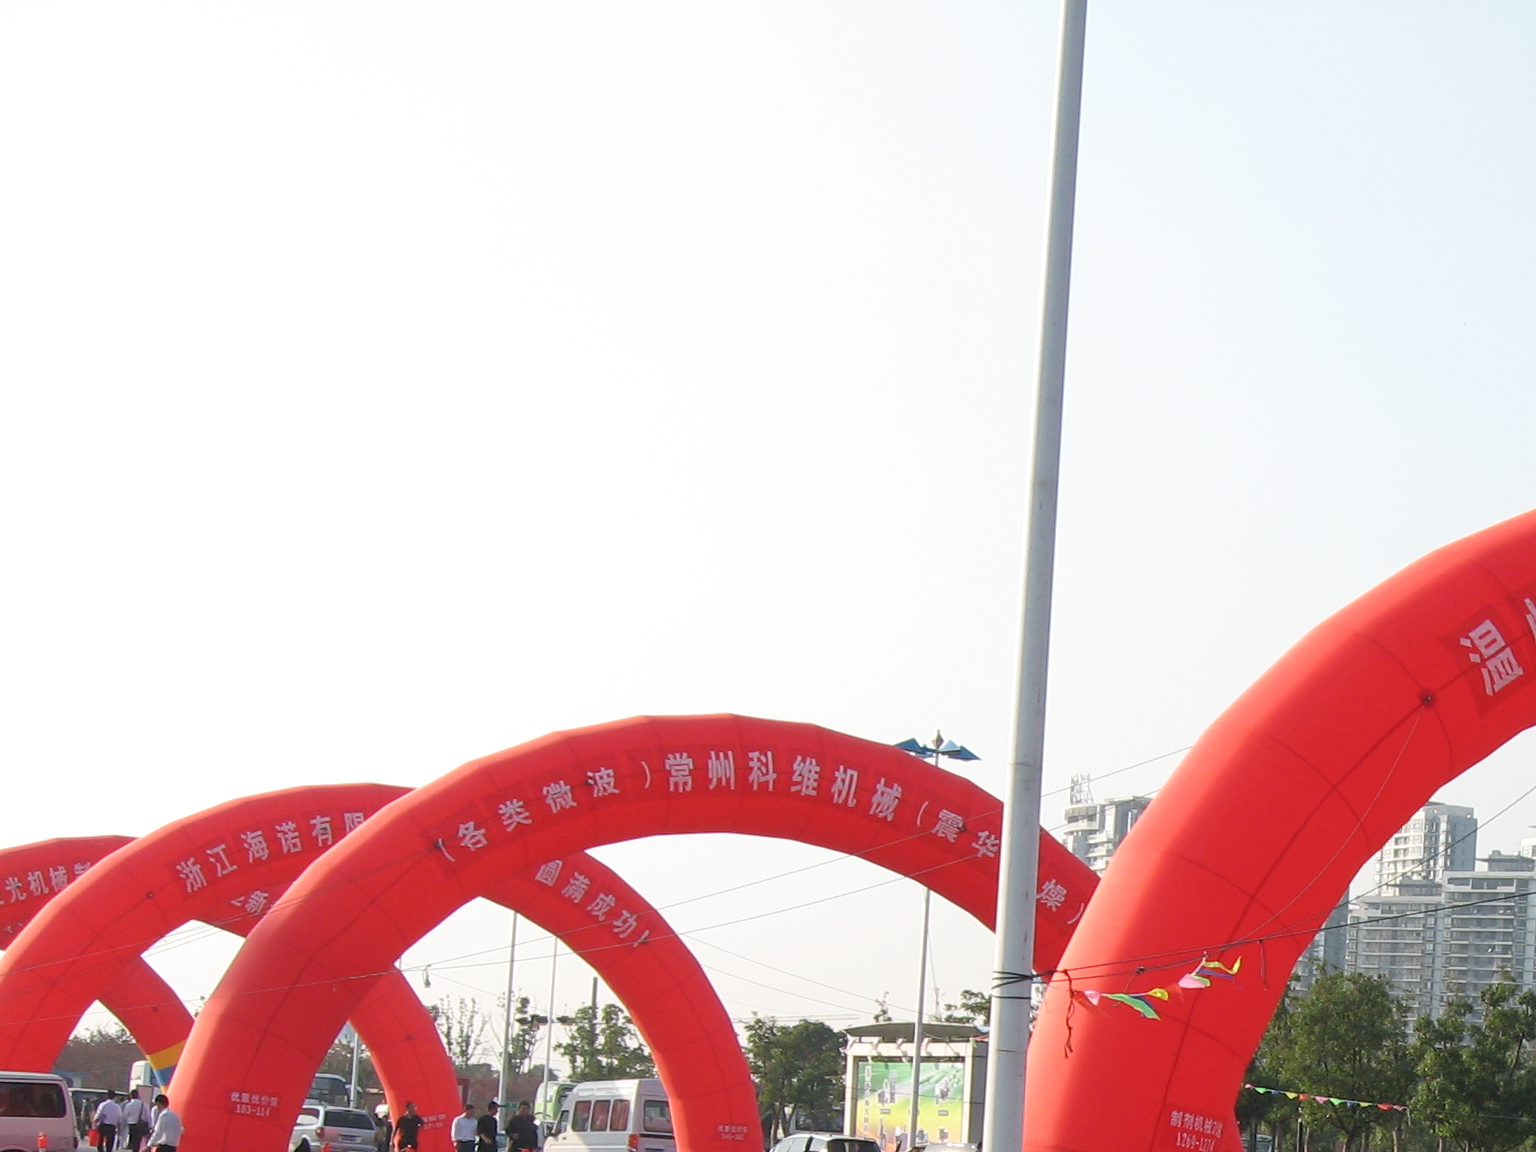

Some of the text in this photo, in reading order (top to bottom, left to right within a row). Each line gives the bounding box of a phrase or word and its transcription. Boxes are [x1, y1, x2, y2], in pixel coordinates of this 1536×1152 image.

[0, 861, 91, 905] 光机械
[437, 750, 1085, 925] (各类微波)常州科维机械(震华燥)
